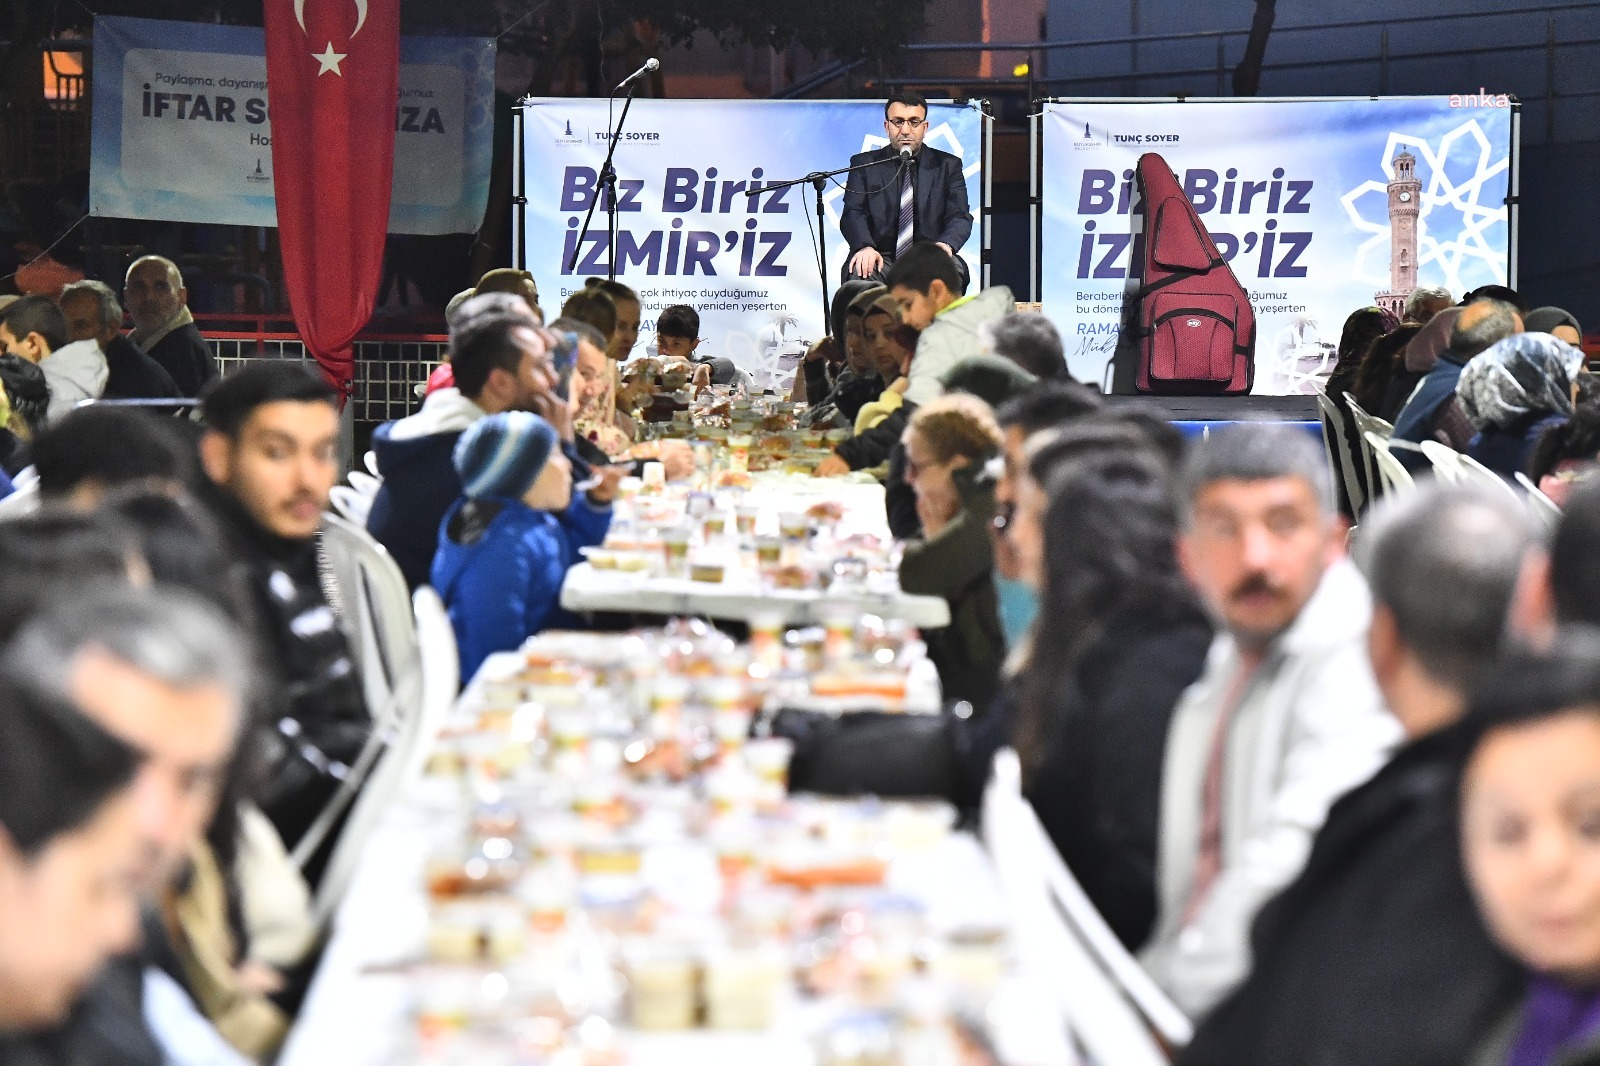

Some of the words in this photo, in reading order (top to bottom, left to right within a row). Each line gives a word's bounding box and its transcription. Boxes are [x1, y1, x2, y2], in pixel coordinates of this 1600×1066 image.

[143, 82, 236, 123] İFTAR
[626, 132, 660, 141] SOYER
[1114, 134, 1143, 144] TUNÇ
[1145, 134, 1180, 142] SOYER
[661, 167, 793, 213] Biriz
[1077, 168, 1144, 215] Bi
[640, 288, 659, 299] çok
[662, 288, 698, 300] ihtiyaç
[700, 288, 769, 300] duyduğumuz
[697, 302, 739, 312] yeniden
[741, 302, 787, 312] yeşerten
[1076, 305, 1090, 314] bu
[1259, 305, 1306, 315] yeşerten
[1077, 322, 1121, 335] RAMA
